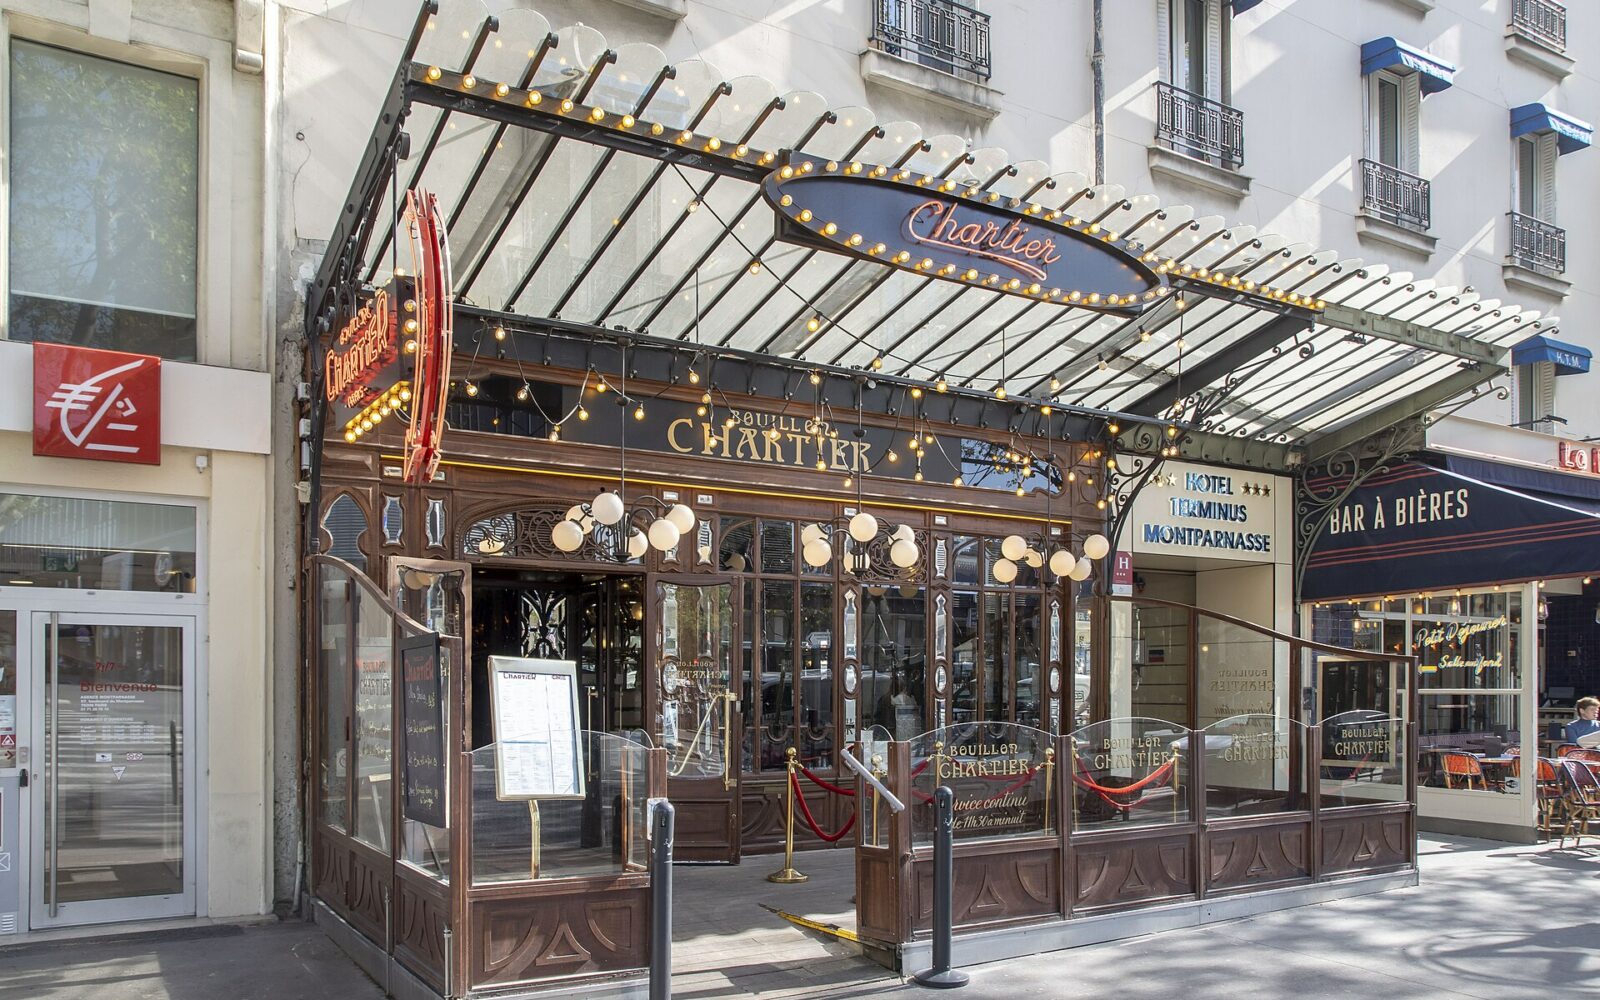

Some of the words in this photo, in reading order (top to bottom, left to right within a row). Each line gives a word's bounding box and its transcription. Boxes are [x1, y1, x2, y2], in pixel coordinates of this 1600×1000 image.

[908, 200, 1062, 281] Chartier
[326, 290, 388, 401] CHARTIER
[1185, 472, 1234, 496] HOTEL
[1170, 497, 1248, 523] TERMINUS
[1330, 504, 1365, 534] BAR
[1374, 496, 1386, 529] À
[1396, 488, 1469, 526] BIÈRES
[1143, 524, 1272, 553] MONTPARNASSE
[1119, 556, 1129, 570] H
[1416, 627, 1445, 648] Petit
[80, 682, 157, 692] Bienvenue
[950, 743, 1019, 757] BOUILLON
[1224, 745, 1289, 762] CHARTIER
[1335, 740, 1391, 756] CHARTIER
[939, 759, 1030, 778] CHARTIER
[953, 799, 983, 812] rvice
[983, 791, 1028, 809] continu
[993, 810, 1026, 825] minuit
